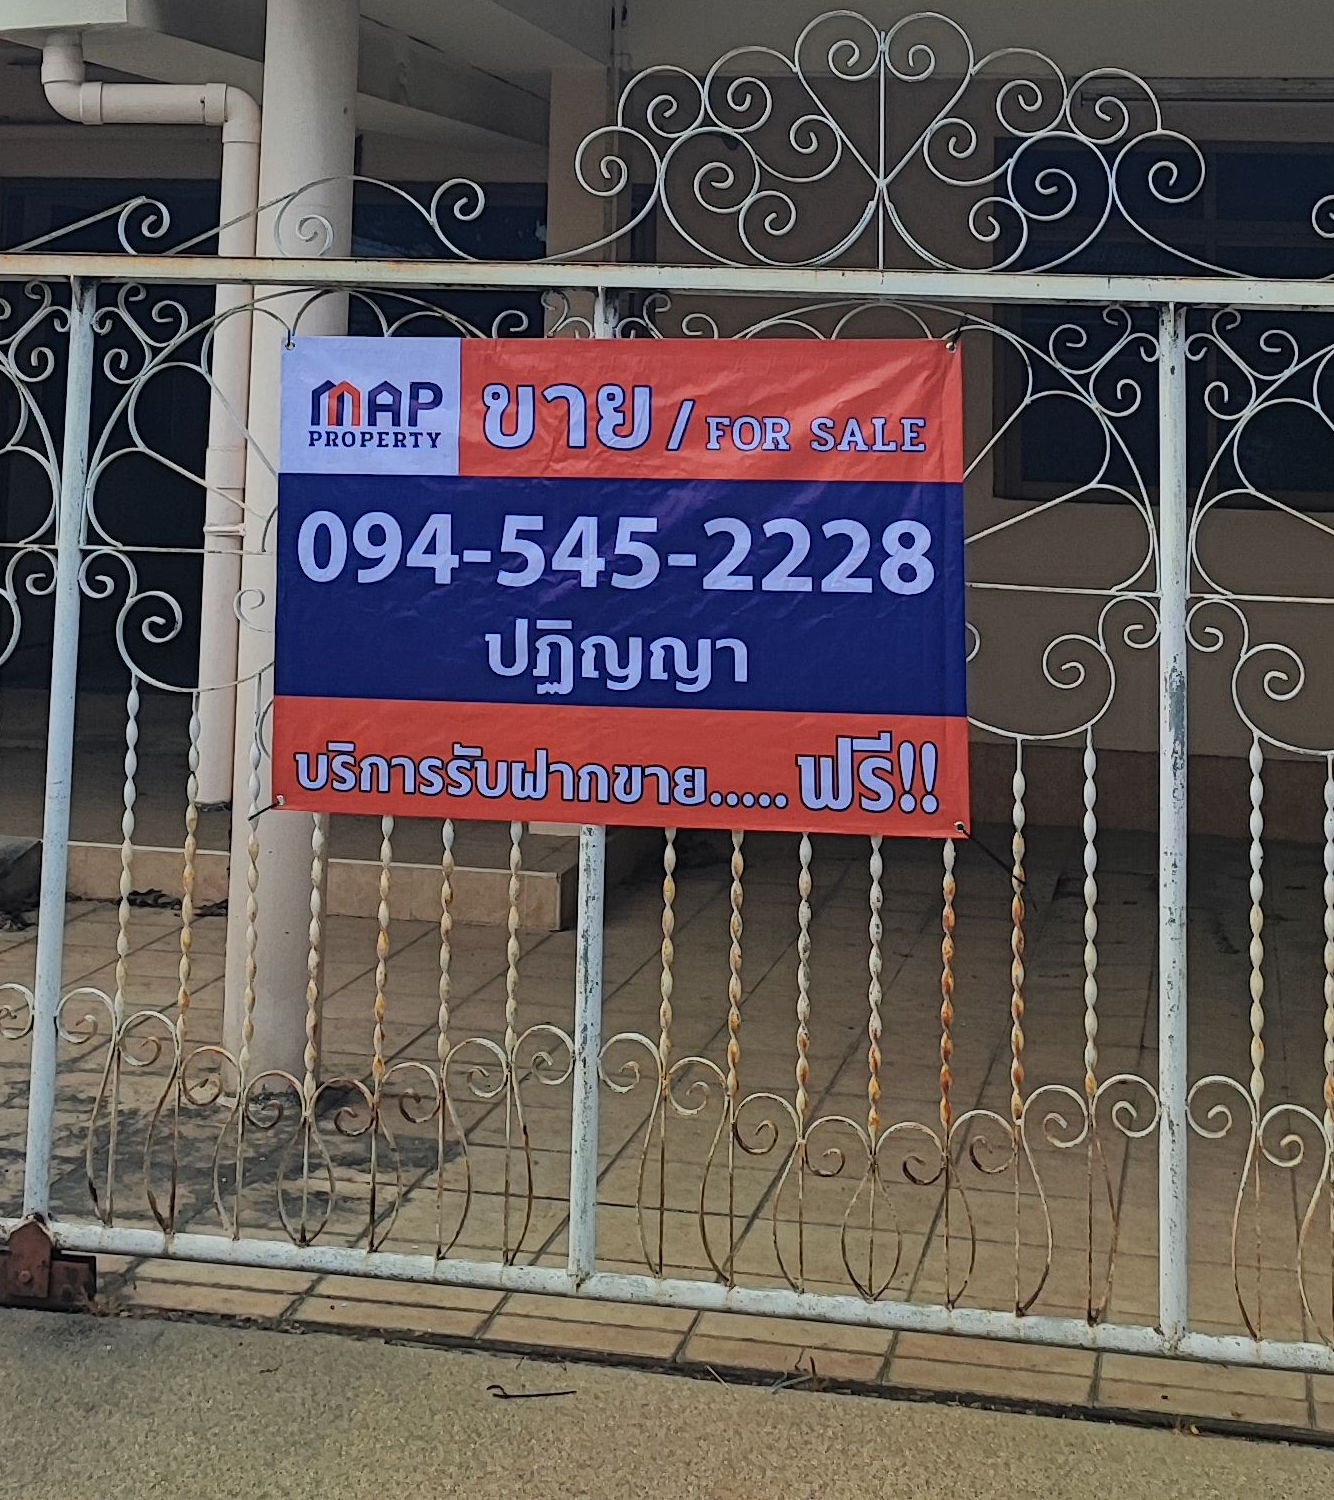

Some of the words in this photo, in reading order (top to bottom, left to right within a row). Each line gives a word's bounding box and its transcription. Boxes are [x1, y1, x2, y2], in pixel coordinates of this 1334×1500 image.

[308, 430, 442, 449] PROPERTY
[311, 379, 444, 427] MAP
[482, 382, 653, 451] ขาย
[666, 399, 696, 452] /
[705, 415, 791, 452] FOR
[810, 416, 927, 453] SALE
[297, 510, 935, 596] 094-545-2228
[484, 618, 748, 695] ปฏิญญา
[795, 730, 940, 815] ฟรี!!
